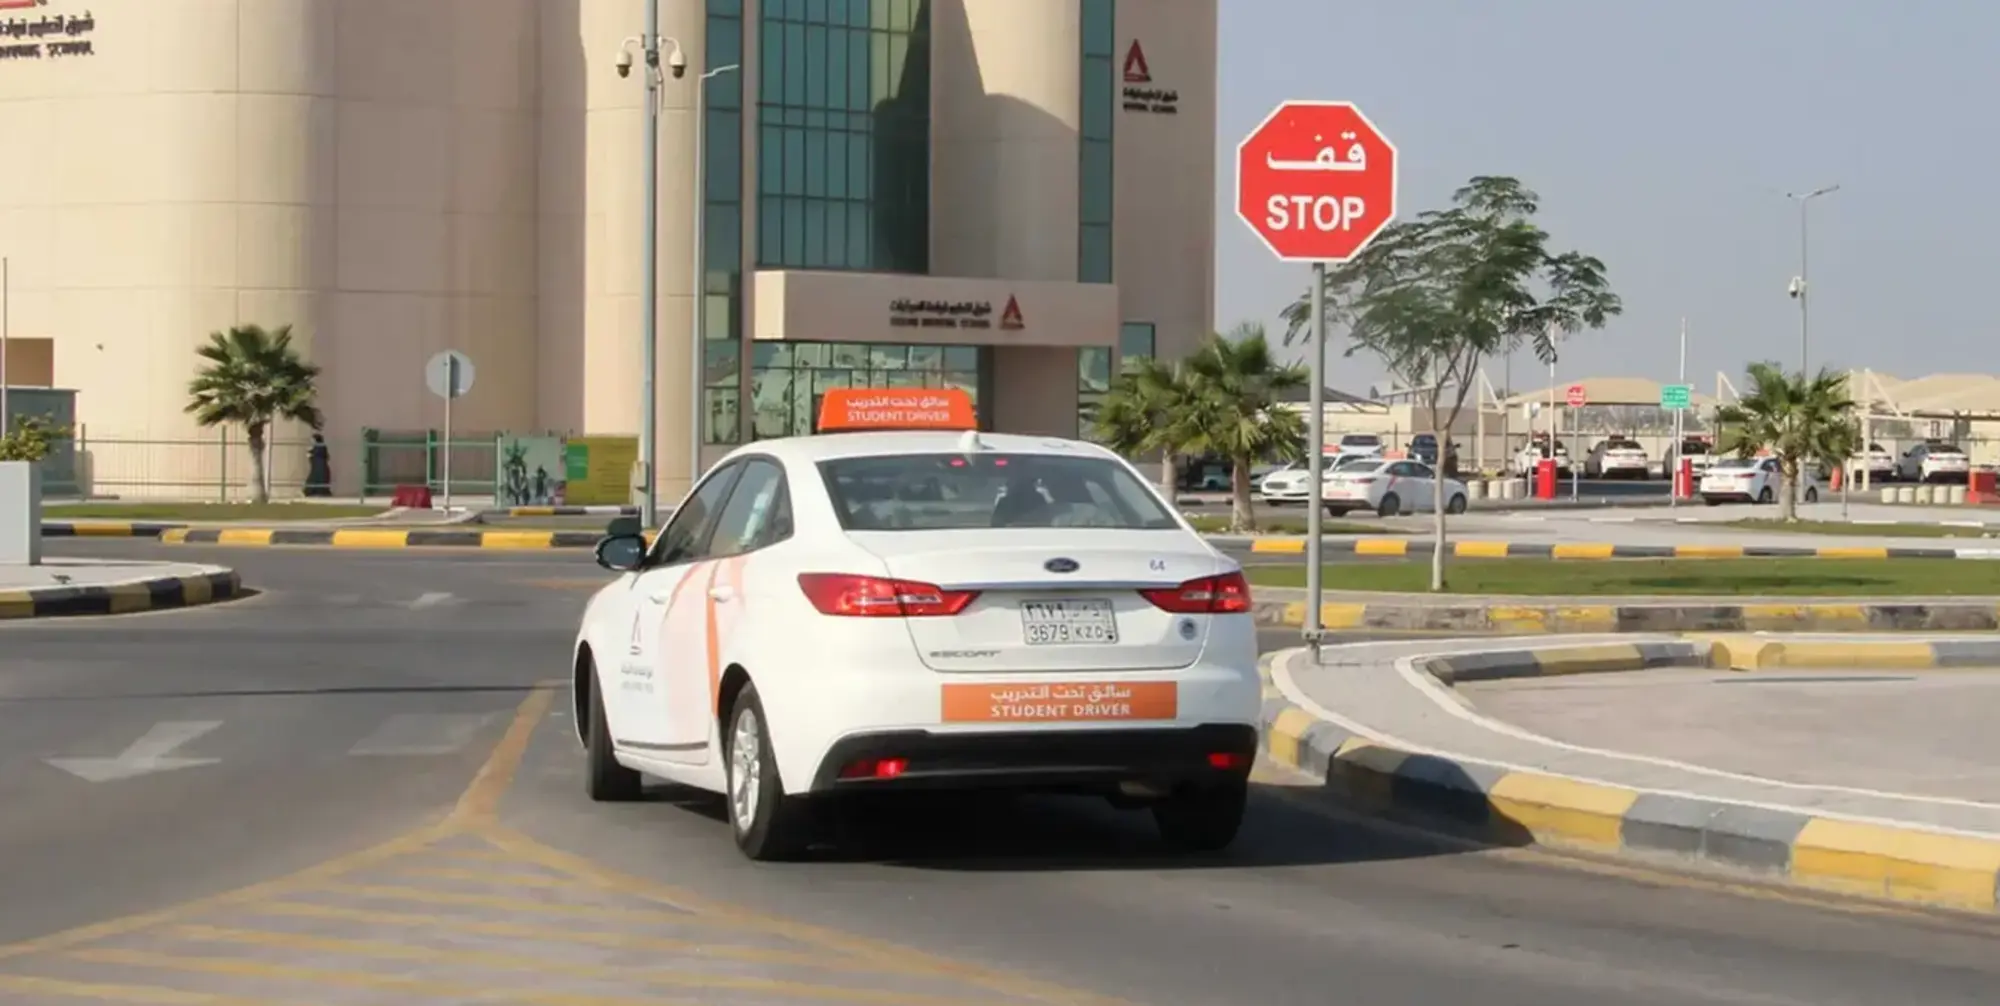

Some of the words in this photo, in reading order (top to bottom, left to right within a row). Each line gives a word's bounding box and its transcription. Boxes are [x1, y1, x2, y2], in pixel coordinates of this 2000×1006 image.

[1266, 130, 1366, 172] قف
[1266, 194, 1365, 231] STOP
[847, 410, 903, 422] STUDENT
[906, 410, 950, 422] DRIVER
[1029, 624, 1069, 641] 3679
[990, 685, 1050, 703] التدريب
[1052, 685, 1085, 699] تحت
[991, 704, 1067, 718] STUDENT
[1073, 703, 1130, 717] DRIVER
